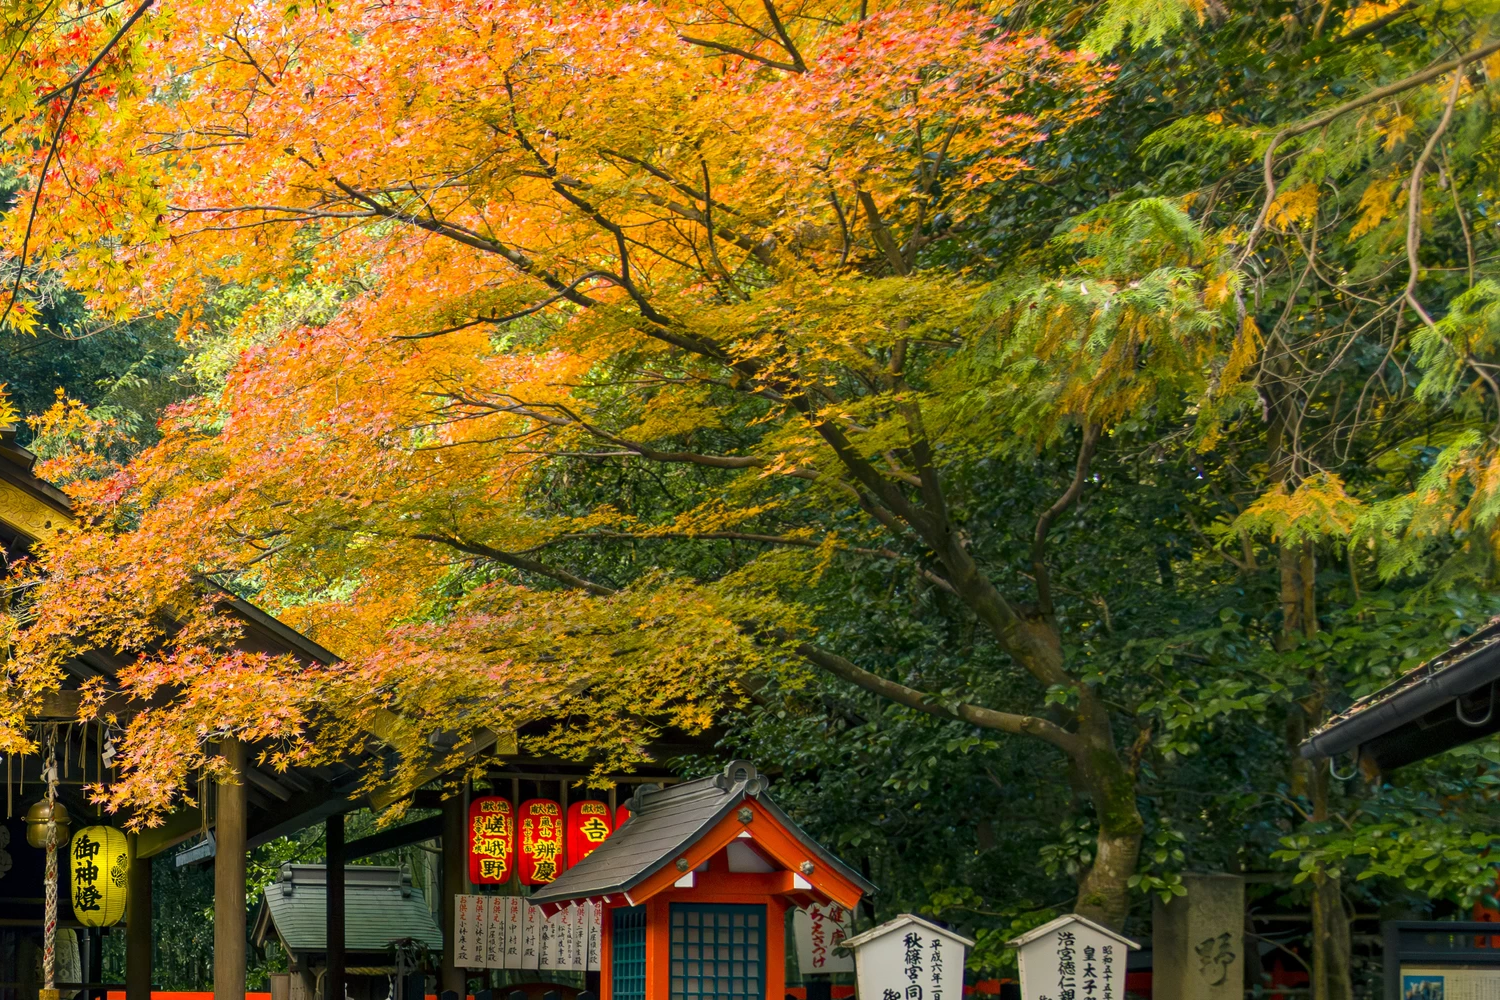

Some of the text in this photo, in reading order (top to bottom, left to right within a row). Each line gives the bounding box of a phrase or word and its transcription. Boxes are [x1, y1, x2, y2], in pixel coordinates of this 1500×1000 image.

[479, 814, 508, 880] 嵯峨野
[73, 834, 102, 912] 御神燈
[475, 896, 483, 922] お供え
[493, 897, 501, 922] お供え
[510, 898, 518, 923] お供え
[527, 906, 535, 923] 供え
[561, 908, 569, 924] 供え
